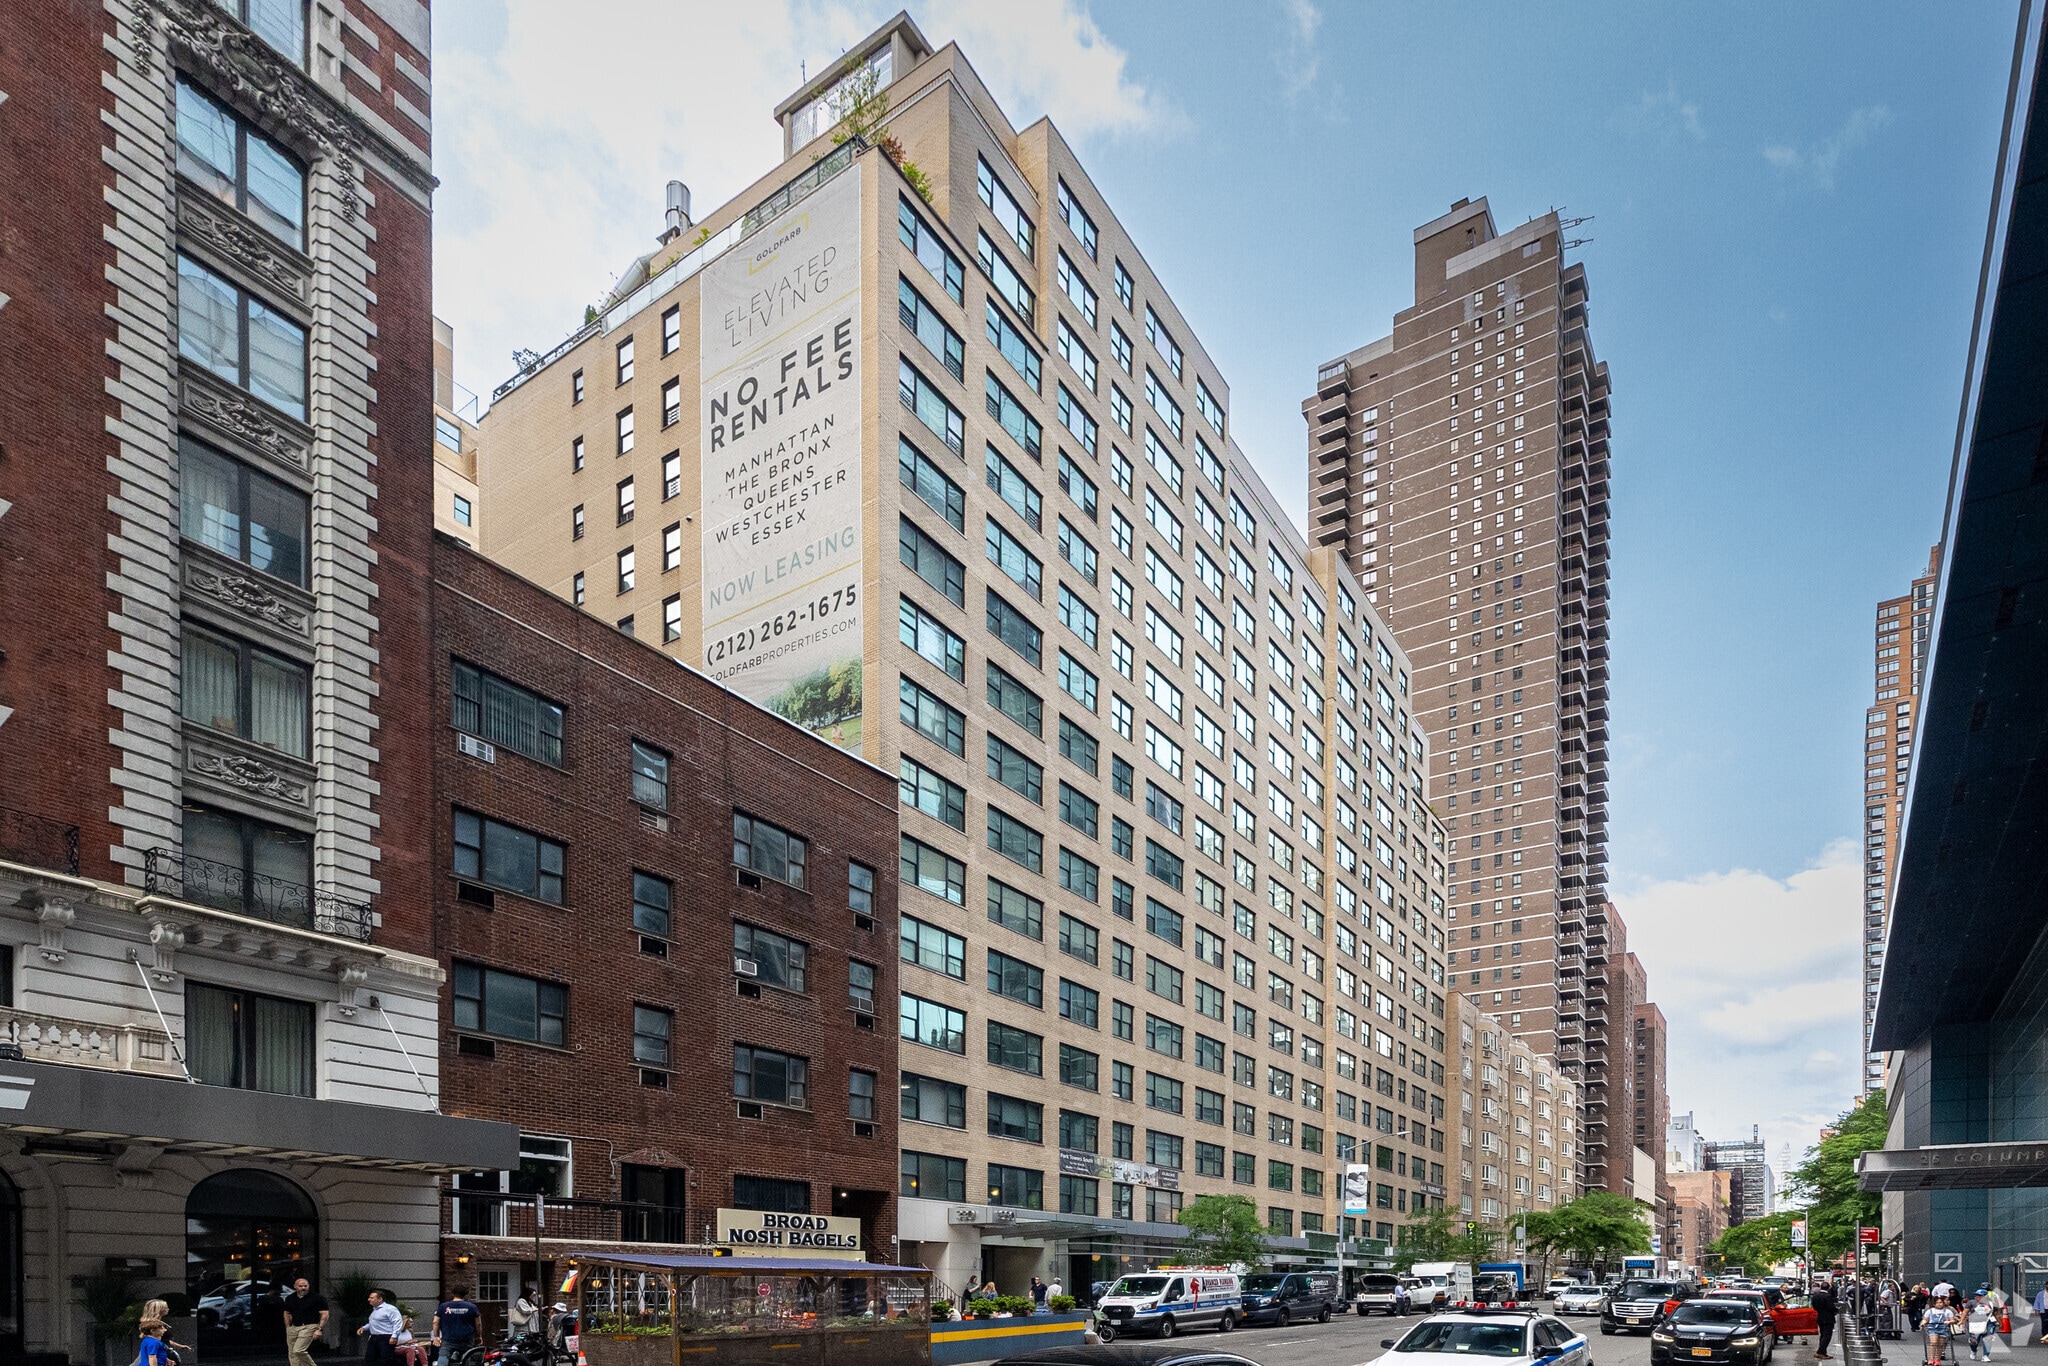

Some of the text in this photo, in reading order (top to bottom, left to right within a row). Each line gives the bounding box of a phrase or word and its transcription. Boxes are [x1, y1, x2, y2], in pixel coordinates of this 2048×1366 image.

[756, 227, 802, 262] GOLDFARB
[724, 246, 837, 331] ELEVATED
[731, 270, 830, 348] LIVING
[710, 317, 853, 425] NO FEE
[710, 351, 853, 453] RENTALS
[725, 413, 835, 484] MANHATTAN
[728, 436, 832, 500] THE BRONX
[715, 469, 847, 544] WESTCHESTER
[743, 465, 816, 511] QUEENS
[751, 509, 807, 546] ESSEX
[709, 526, 855, 610] NOW LEASING
[707, 584, 857, 667] (212) 262-1675
[728, 1228, 857, 1247] NOSH BAGELS
[763, 1213, 828, 1231] BROAD
